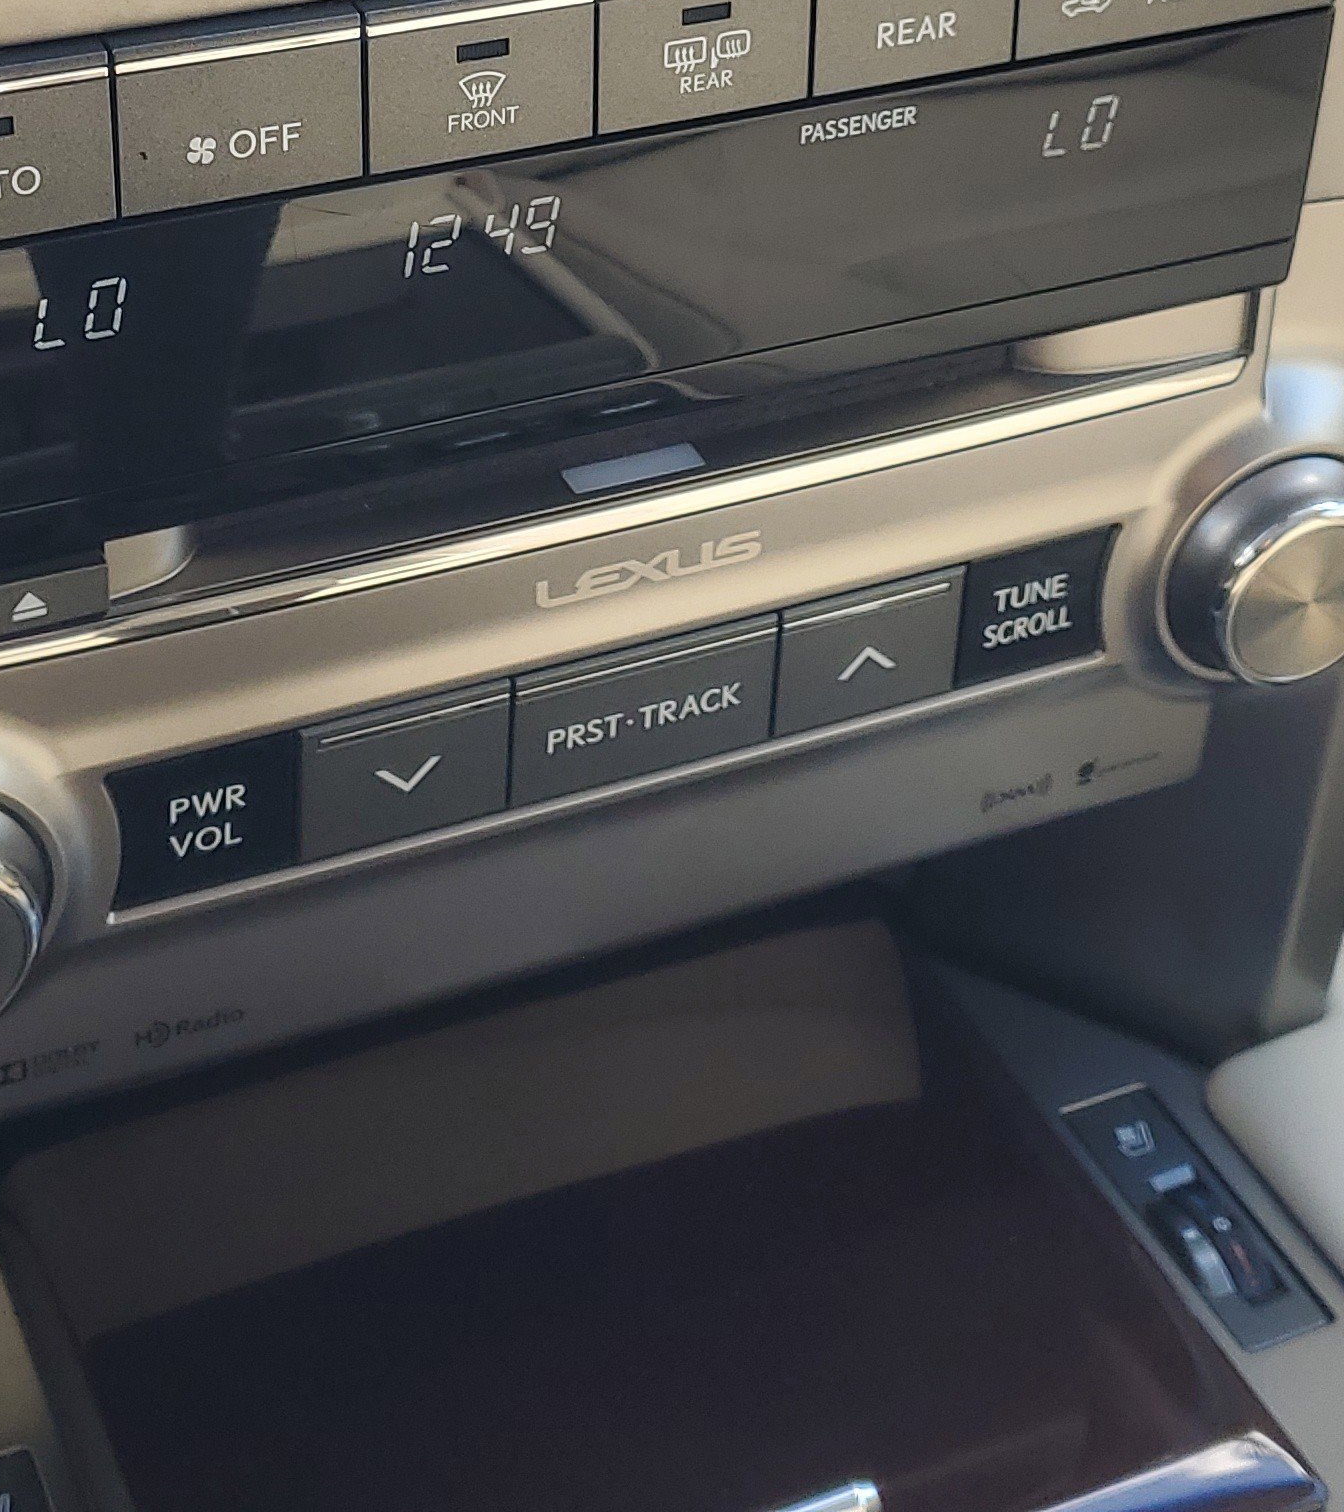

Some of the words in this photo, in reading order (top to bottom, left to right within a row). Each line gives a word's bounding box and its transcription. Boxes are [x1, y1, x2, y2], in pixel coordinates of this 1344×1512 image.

[875, 11, 958, 50] REAR
[679, 67, 734, 95] REAR
[446, 104, 520, 134] FRONT
[799, 104, 918, 145] PASSENGER
[228, 121, 303, 161] OFF
[535, 530, 762, 609] LEXUS
[994, 573, 1069, 612] TUNE
[982, 605, 1073, 649] SCROLL
[169, 783, 247, 825] PWR
[169, 822, 243, 859] VOL
